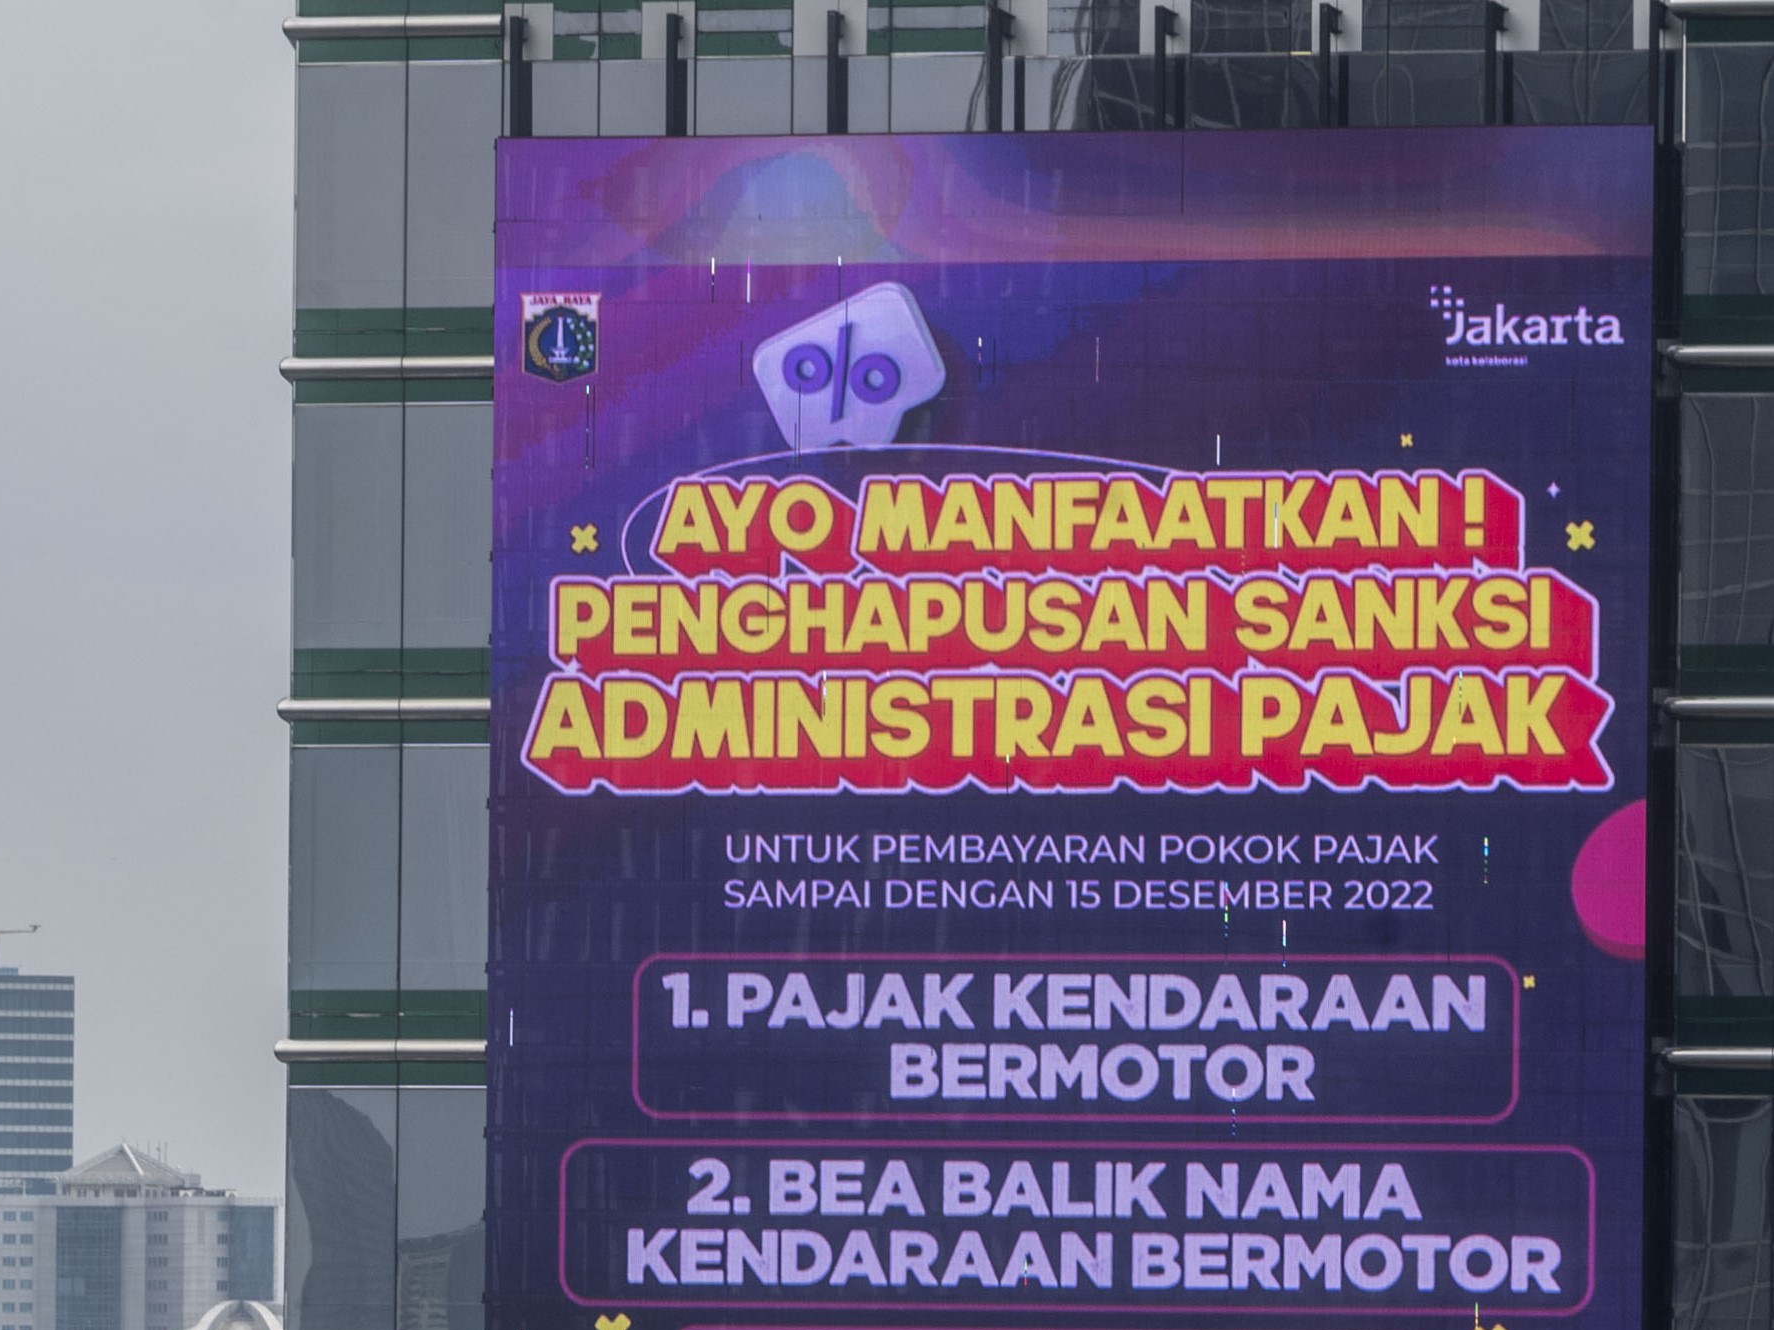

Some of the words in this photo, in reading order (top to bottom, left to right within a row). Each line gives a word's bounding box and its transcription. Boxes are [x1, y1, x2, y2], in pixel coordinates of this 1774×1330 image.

[529, 295, 558, 306] JAYA
[563, 295, 592, 306] RAYA
[656, 482, 834, 554] AYO
[858, 478, 1440, 553] MANFAATKAN
[558, 580, 1208, 656] PENGHAPUSAN
[1234, 577, 1551, 653] SANKSI
[530, 678, 1213, 760] ADMINISTRASI
[1240, 675, 1566, 757] PAJAK
[725, 834, 860, 864] UNTUK
[872, 834, 1144, 864] PEMBAYARAN
[1159, 834, 1302, 864] POKOK
[1314, 834, 1439, 864] PAJAK
[724, 880, 870, 909] SAMPAI
[884, 880, 1054, 909] DENGAN
[1066, 880, 1102, 909] 15
[1113, 880, 1333, 909] DESEMBER
[1343, 880, 1434, 909] 2022
[662, 972, 710, 1028] 1.
[726, 972, 976, 1030] PAJAK
[992, 973, 1486, 1031] KENDARAAN
[889, 1043, 1316, 1102] BERMOTOR
[687, 1158, 752, 1215] 2.
[768, 1160, 927, 1216] BEA
[941, 1161, 1168, 1218] BALIK
[1185, 1163, 1423, 1220] NAMA
[626, 1229, 1114, 1289] KENDARAAN
[1130, 1233, 1562, 1293] BERMOTOR
